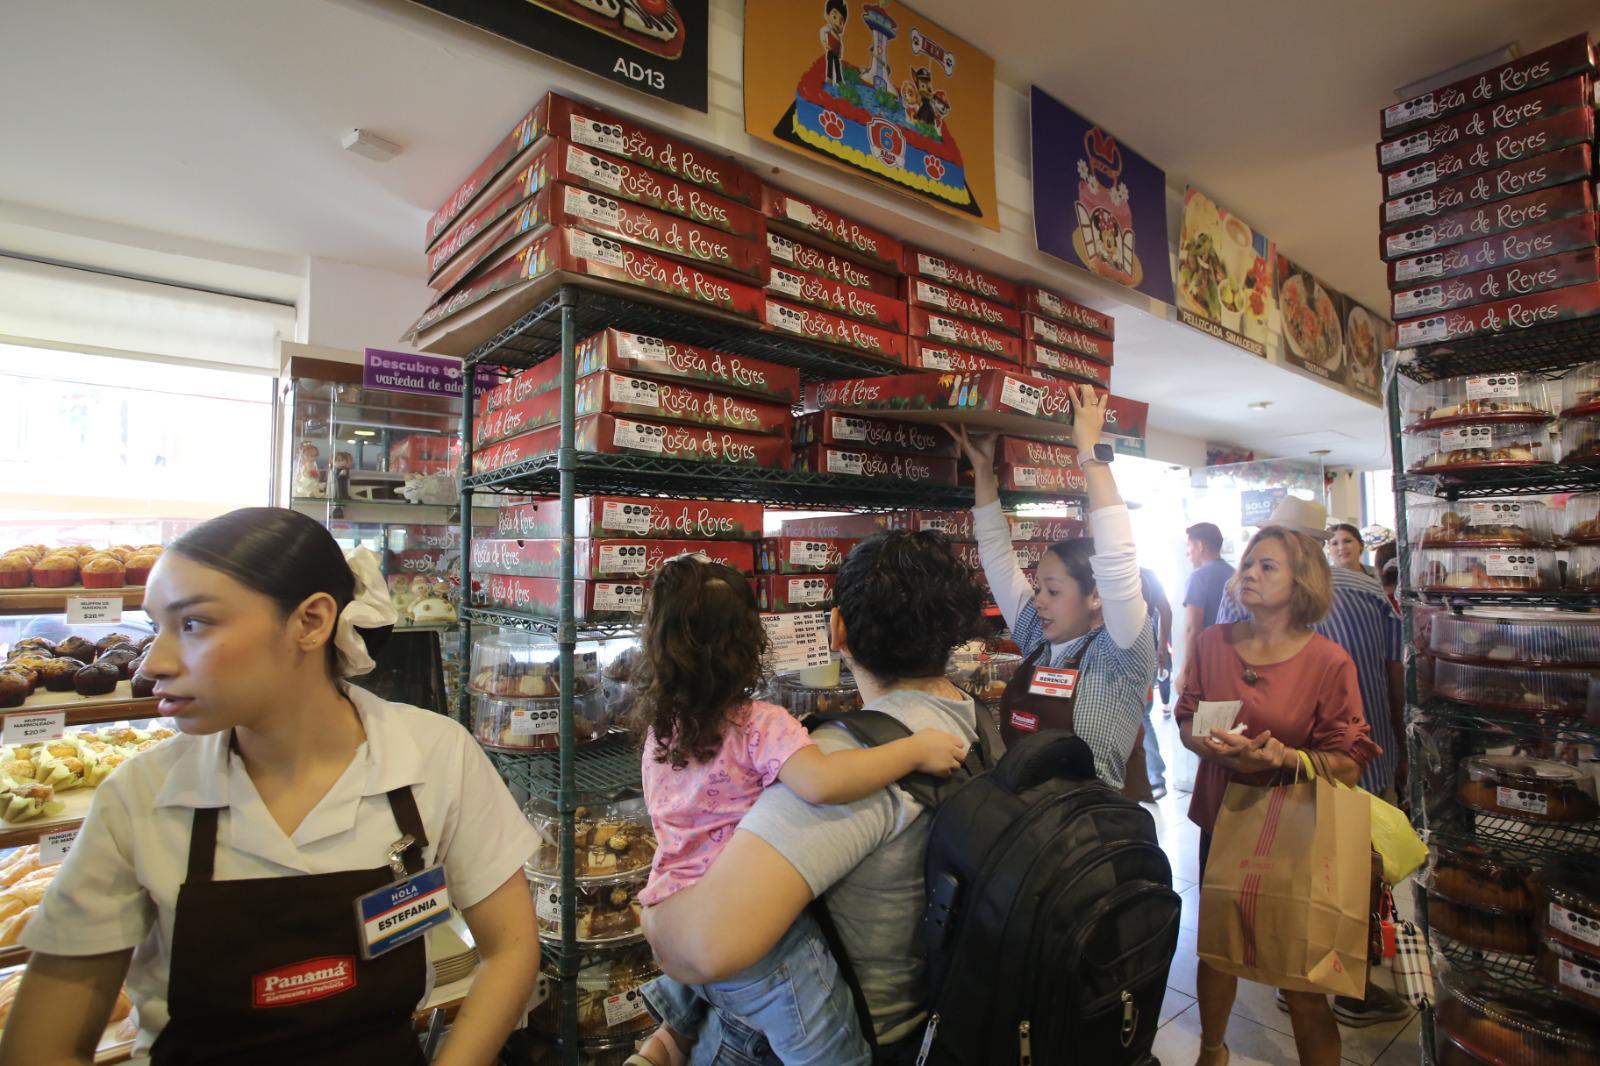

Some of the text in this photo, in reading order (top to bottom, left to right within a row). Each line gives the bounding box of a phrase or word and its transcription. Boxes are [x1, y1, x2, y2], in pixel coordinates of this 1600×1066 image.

[613, 57, 665, 89] AD13
[1427, 61, 1550, 118] osca de Reyes
[881, 127, 893, 150] 6
[1427, 100, 1542, 152] osca de Reyes
[614, 126, 654, 160] osca
[660, 144, 677, 172] de
[682, 152, 720, 184] Reyes
[1436, 131, 1547, 178] sca de Reyes
[620, 165, 662, 199] Rosca
[668, 184, 684, 212] de
[689, 191, 727, 222] Reyes
[1470, 177, 1490, 200] de
[1497, 167, 1547, 194] Reyes
[616, 208, 729, 259] Rosca de Reyes
[1470, 210, 1490, 233] de
[1497, 202, 1547, 229] Reyes
[837, 219, 848, 242] de
[852, 225, 877, 252] Reyes
[793, 244, 869, 286] Rosca de Reyes
[1441, 234, 1553, 274] sca de Reyes
[622, 251, 731, 301] Rosca de Reyes
[1441, 267, 1558, 308] osca de Reyes
[799, 276, 877, 316] Rosca de Reyes
[970, 298, 981, 318] de
[981, 302, 1003, 322] Reyes
[800, 311, 833, 336] Rosca
[837, 320, 850, 343] de
[852, 325, 880, 348] Reyes
[1183, 311, 1223, 338] PELLIZCADA
[1446, 303, 1559, 338] sca de Reyes
[971, 326, 982, 346] de
[981, 330, 1003, 351] Reyes
[370, 355, 439, 375] Descubre
[665, 344, 707, 373] Rosca
[712, 355, 727, 380] de
[731, 359, 765, 385] Reyes
[375, 373, 441, 391] variedad de
[816, 380, 880, 408] Rosca de Reyes
[661, 386, 699, 413] Rosca
[704, 393, 719, 421] de
[723, 397, 758, 424] Reyes
[1039, 386, 1070, 416] Rosca
[660, 426, 697, 455] Rosca
[702, 432, 717, 458] de
[721, 435, 755, 463] Reyes
[863, 420, 936, 450] Rosca de Reyes
[859, 453, 930, 481] Rosca de Reyes
[640, 513, 670, 534] sca
[676, 506, 693, 535] de
[697, 508, 733, 537] Reyes
[391, 885, 418, 902] HOLA
[378, 898, 437, 931] ESTEFANIA
[264, 961, 347, 992] Panamá
